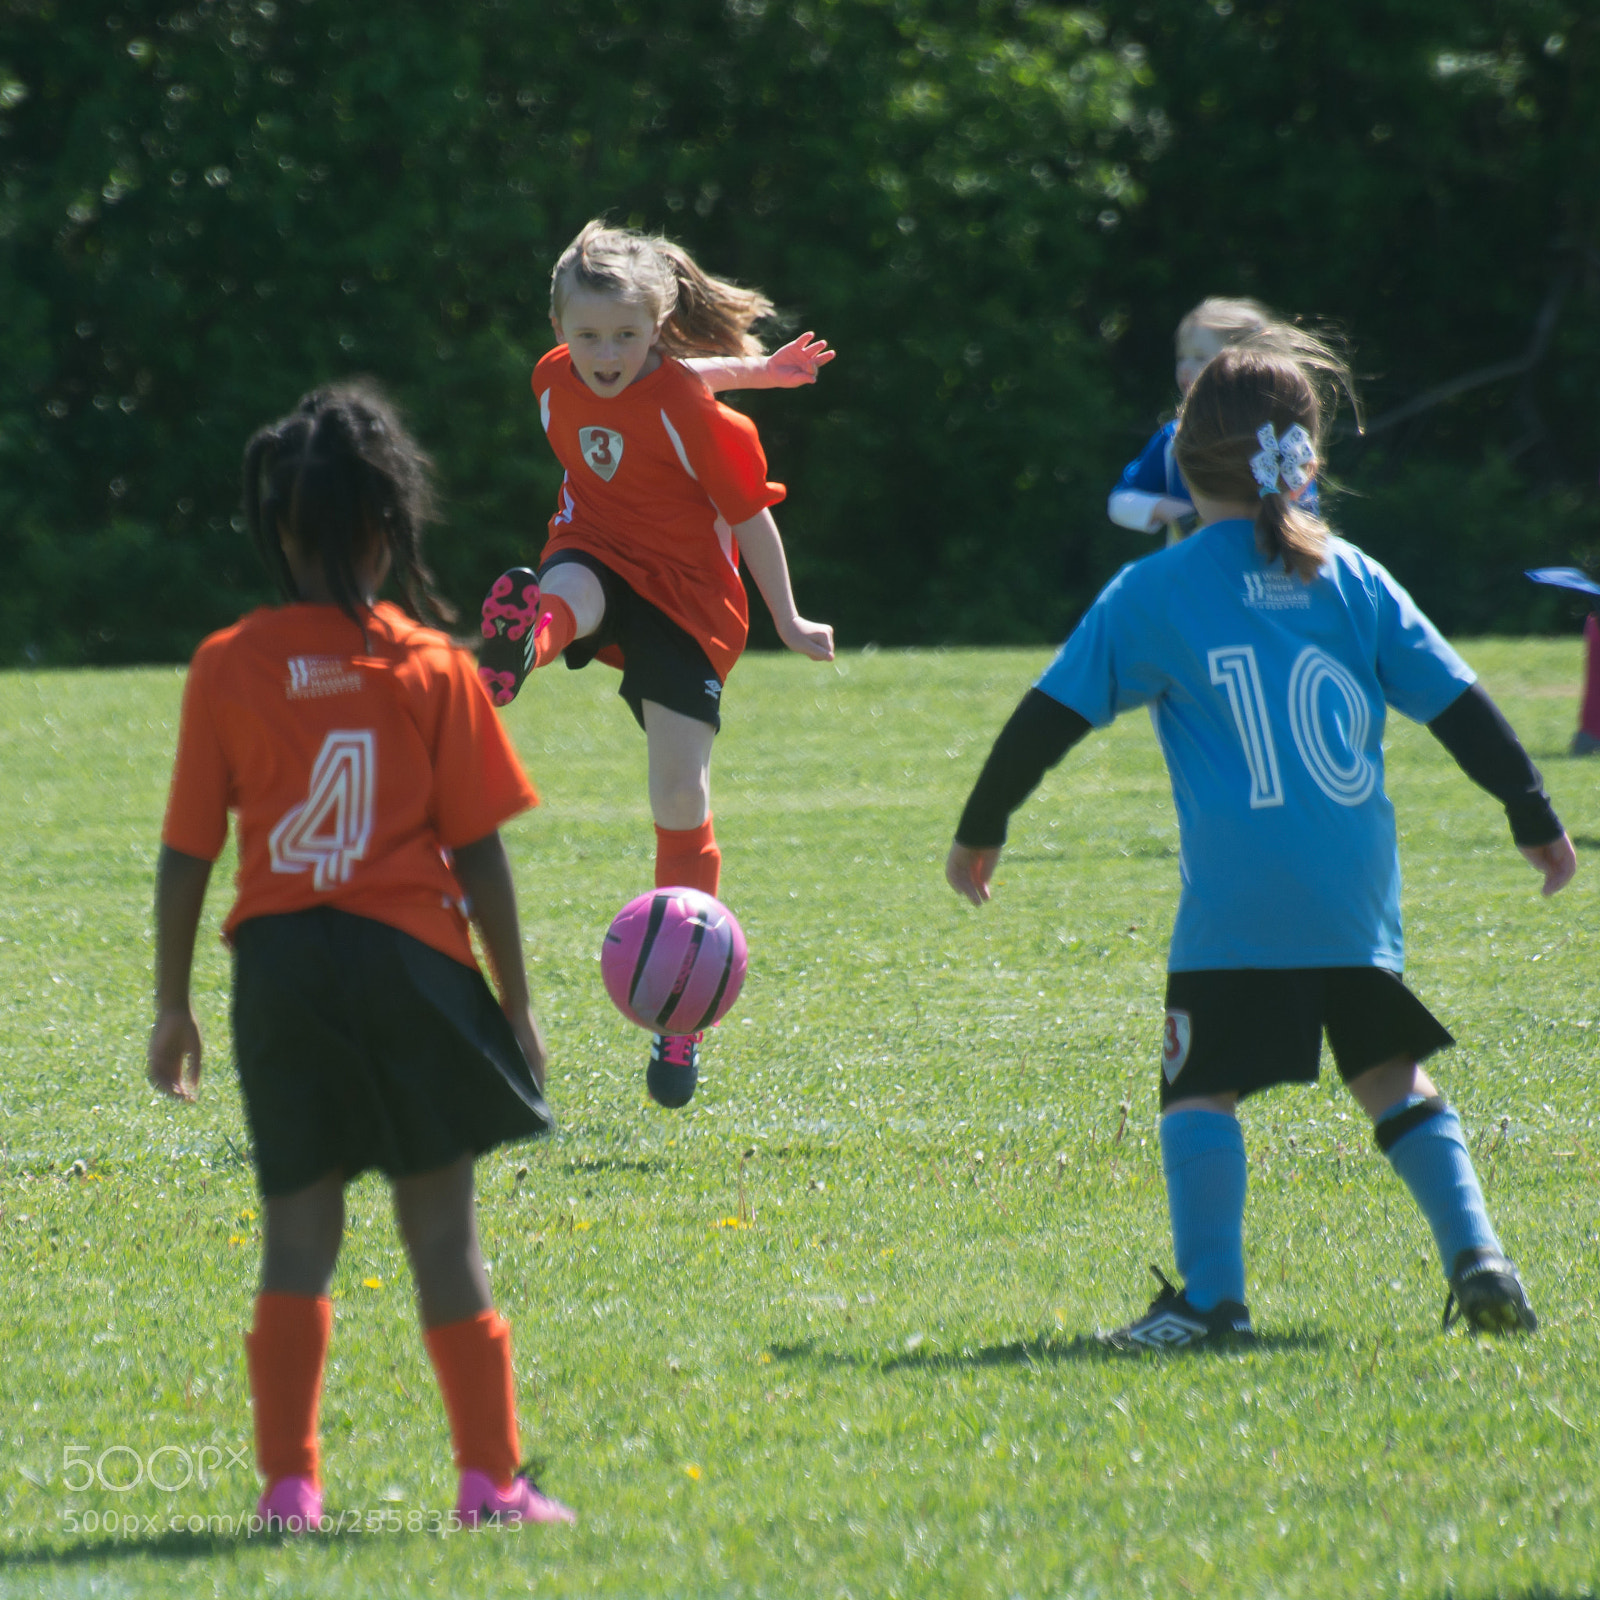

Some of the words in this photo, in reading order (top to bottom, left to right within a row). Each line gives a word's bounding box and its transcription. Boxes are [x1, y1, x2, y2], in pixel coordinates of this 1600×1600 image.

[591, 429, 611, 465] 3
[1207, 645, 1375, 809] 10
[268, 730, 374, 891] 4
[1164, 1016, 1180, 1061] 3
